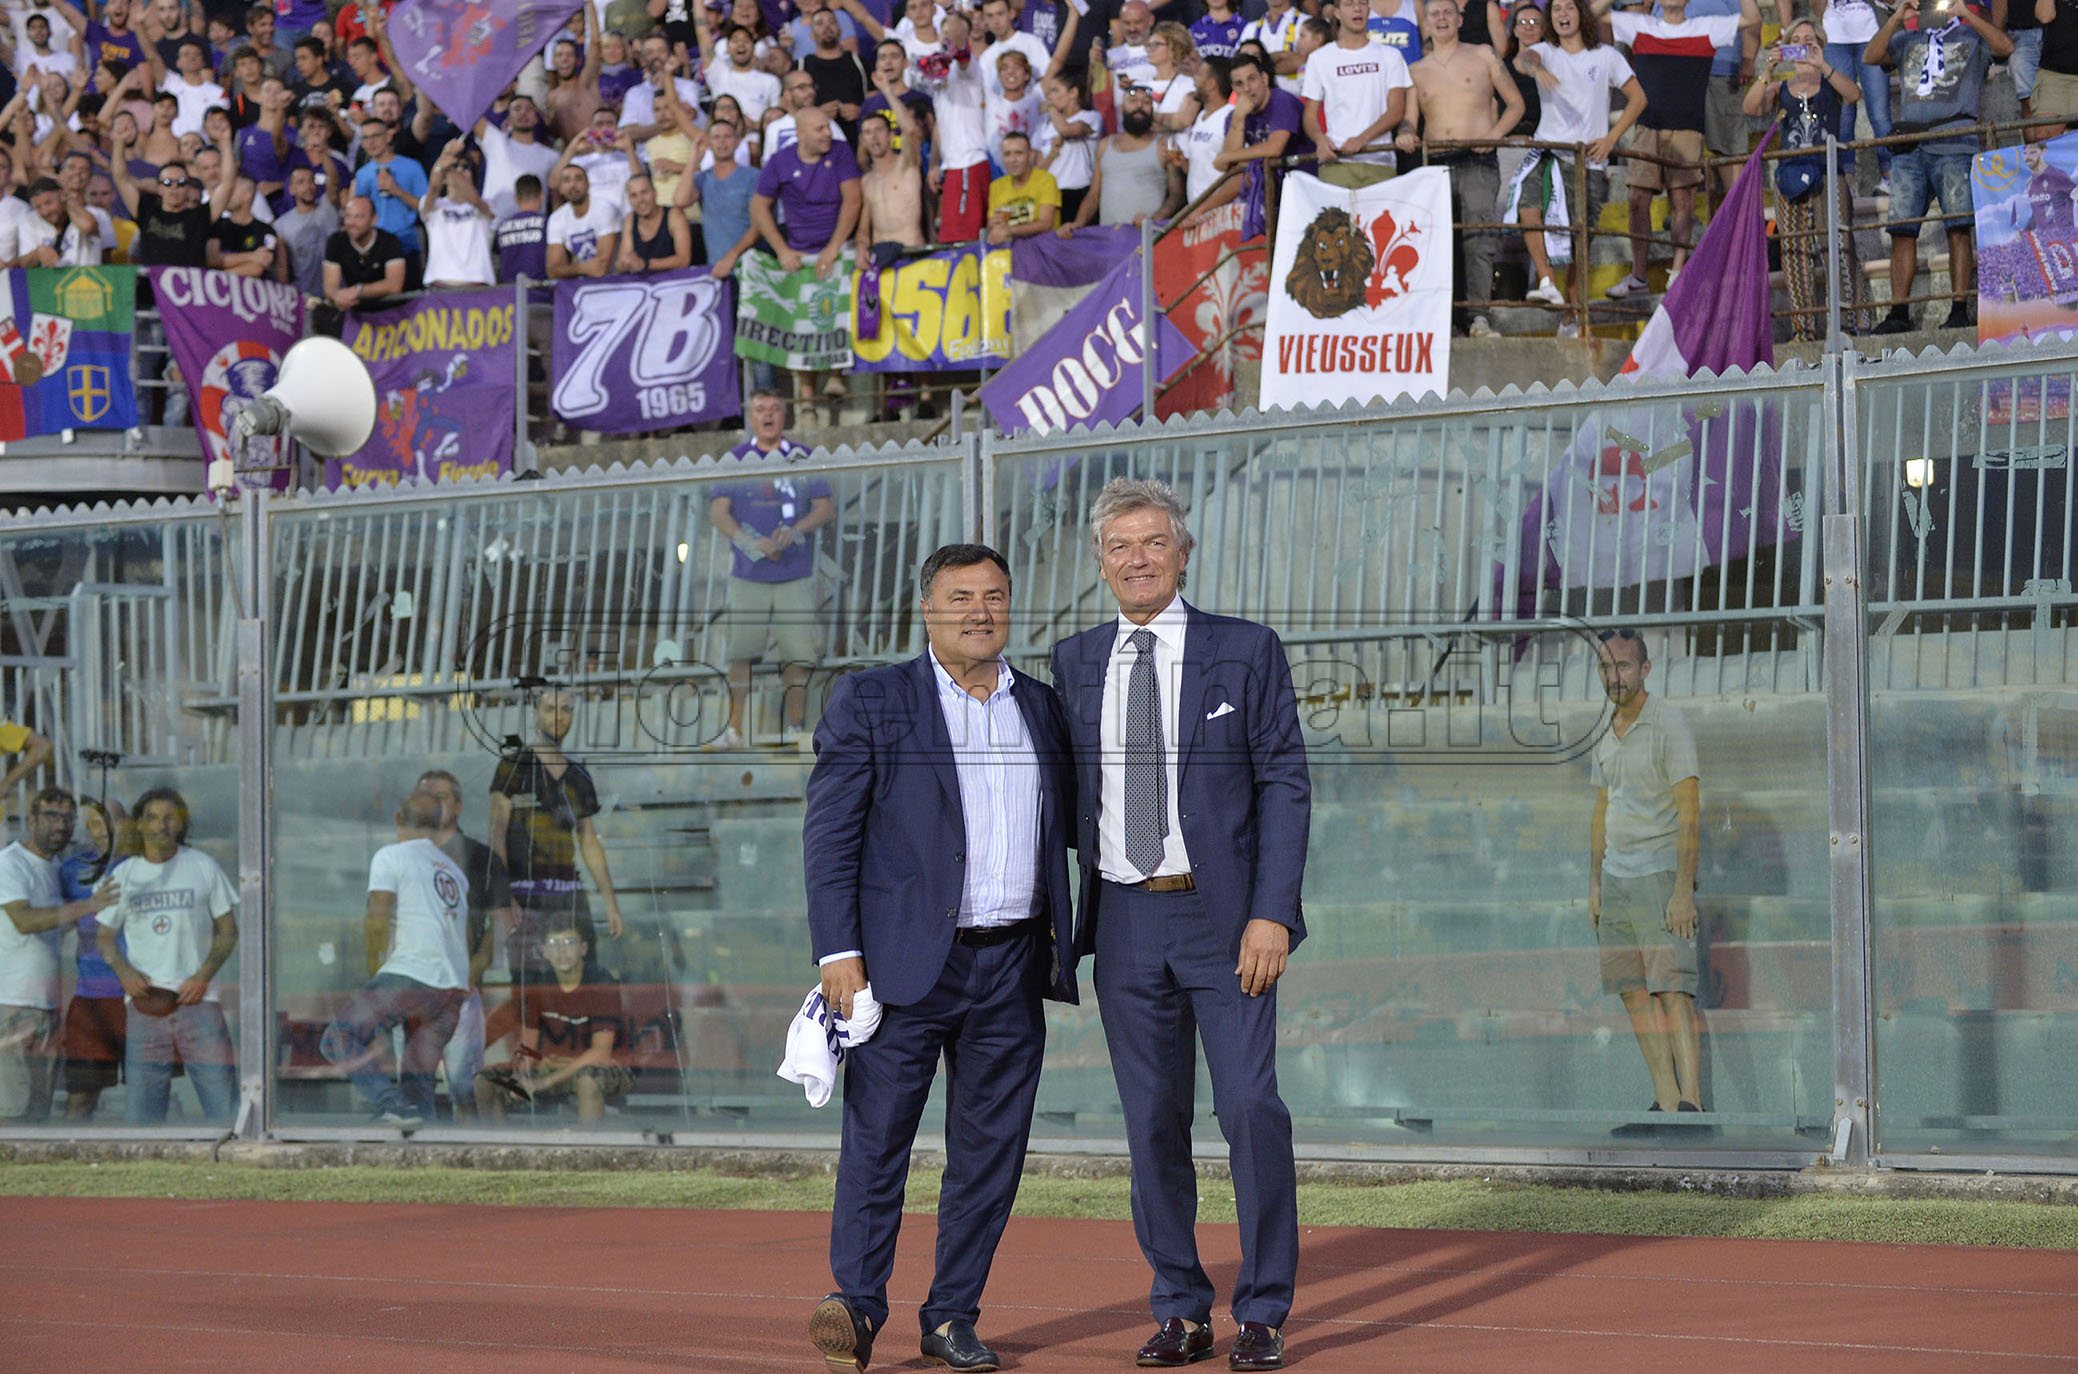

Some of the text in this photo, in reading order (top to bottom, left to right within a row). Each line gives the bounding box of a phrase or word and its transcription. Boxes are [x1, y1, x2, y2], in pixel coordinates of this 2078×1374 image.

[552, 275, 722, 419] 7B
[1279, 332, 1434, 375] VIEUSSEUX
[635, 381, 706, 420] 1965
